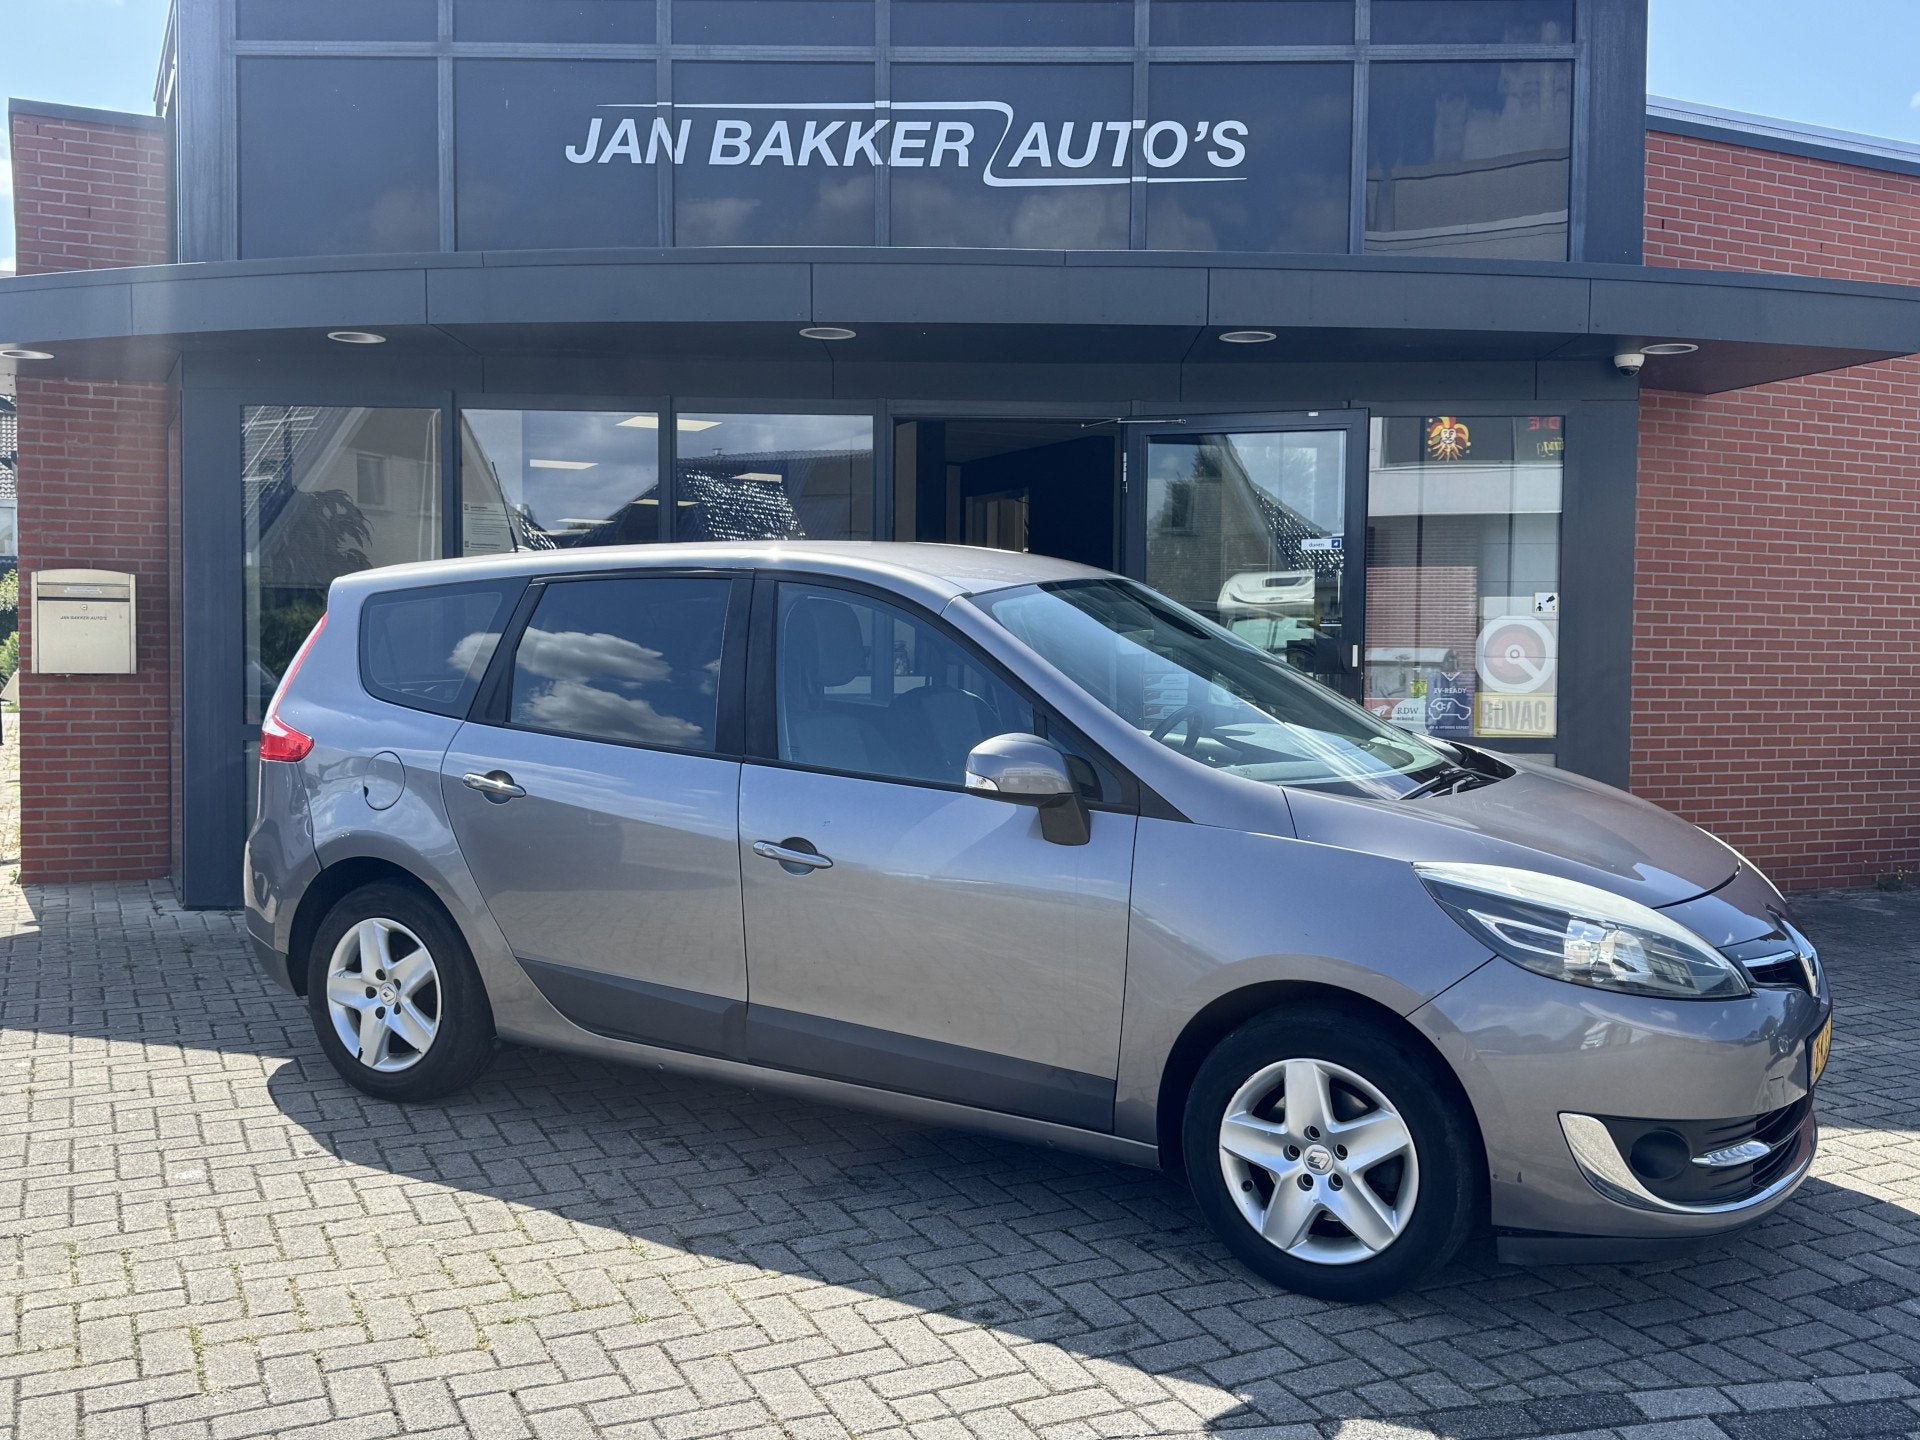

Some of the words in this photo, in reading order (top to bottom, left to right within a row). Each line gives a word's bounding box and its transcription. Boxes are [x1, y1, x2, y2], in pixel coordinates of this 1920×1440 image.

[565, 118, 693, 165] JAN
[708, 119, 975, 168] BAKKER
[1007, 120, 1248, 168] AUTO'S
[1397, 707, 1419, 715] RDW
